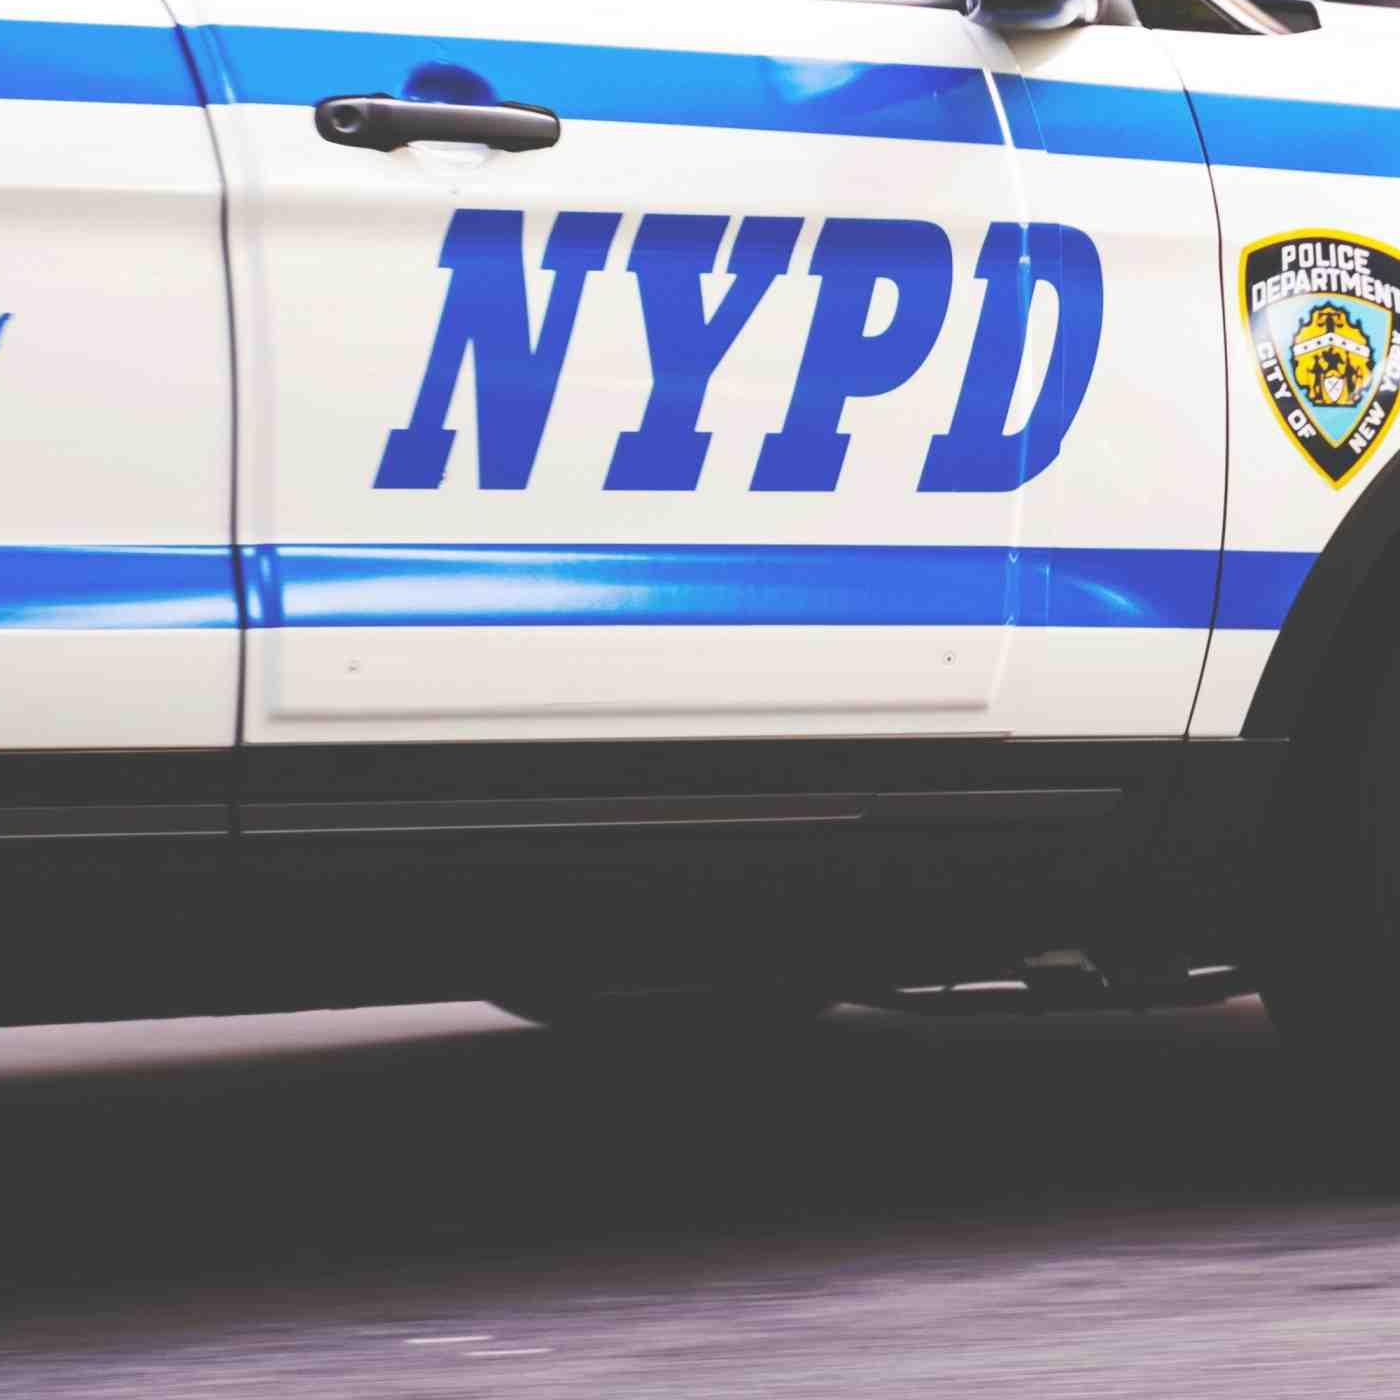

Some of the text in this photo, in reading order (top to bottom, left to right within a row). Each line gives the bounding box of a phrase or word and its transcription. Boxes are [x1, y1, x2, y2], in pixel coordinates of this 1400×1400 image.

[1281, 242, 1370, 275] POLICE
[371, 208, 1104, 492] NYPD
[1256, 341, 1292, 399] CITY
[1287, 408, 1317, 439] OF
[1348, 401, 1385, 454] NEW
